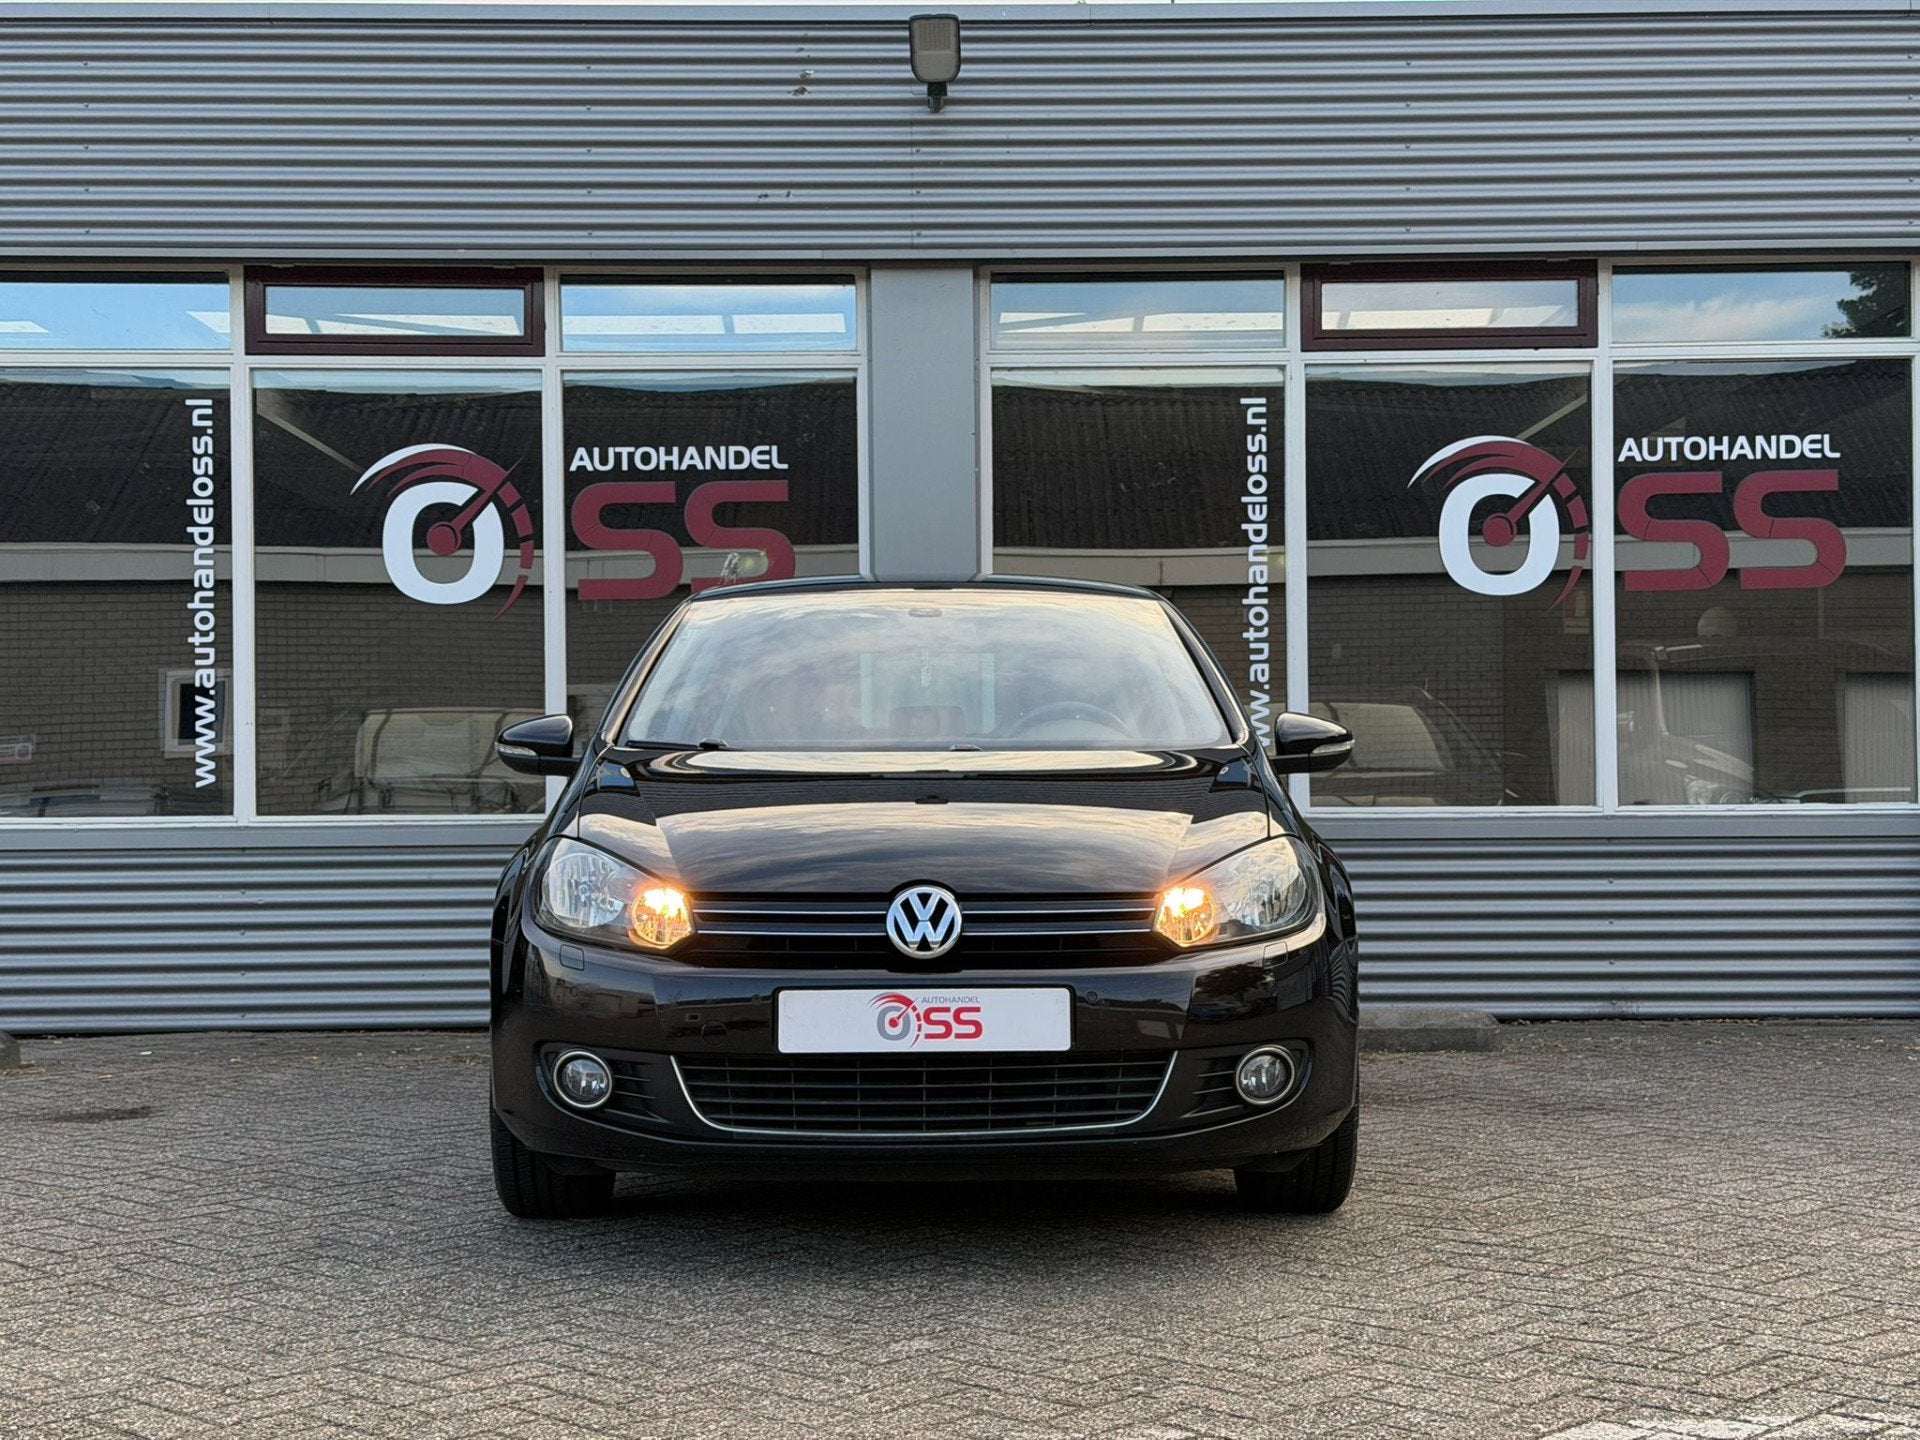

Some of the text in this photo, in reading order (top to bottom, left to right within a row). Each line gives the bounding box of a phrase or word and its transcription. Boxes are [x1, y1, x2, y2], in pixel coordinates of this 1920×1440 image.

[568, 444, 789, 472] AUTOHANDEL
[1617, 433, 1841, 463] AUTOHANDEL
[1239, 396, 1271, 748] ww.autohandeloss.nl
[185, 398, 217, 789] www.autohandeloss.nl
[921, 995, 981, 1004] AUTOHANDEL
